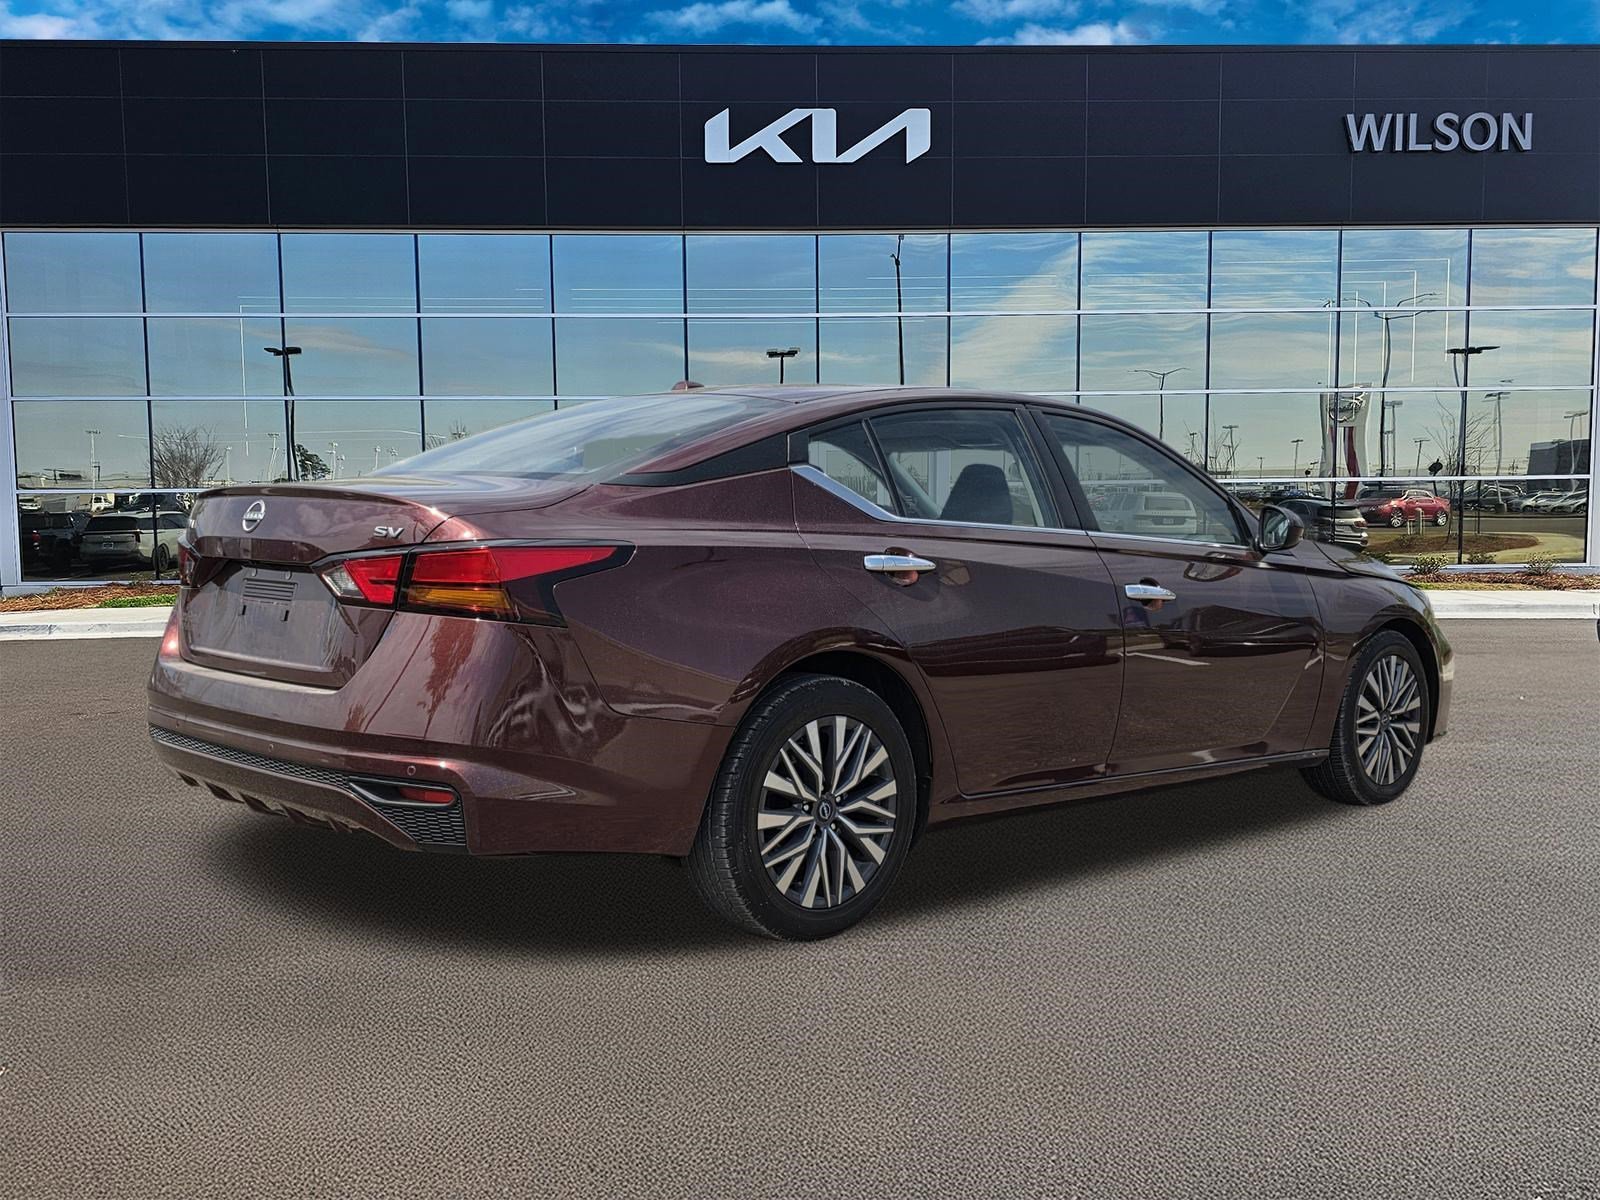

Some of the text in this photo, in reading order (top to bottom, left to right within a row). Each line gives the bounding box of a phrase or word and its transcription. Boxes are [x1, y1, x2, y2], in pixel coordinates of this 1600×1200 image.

[704, 108, 931, 163] KIA
[1346, 112, 1533, 151] WILSON
[373, 525, 404, 538] SV
